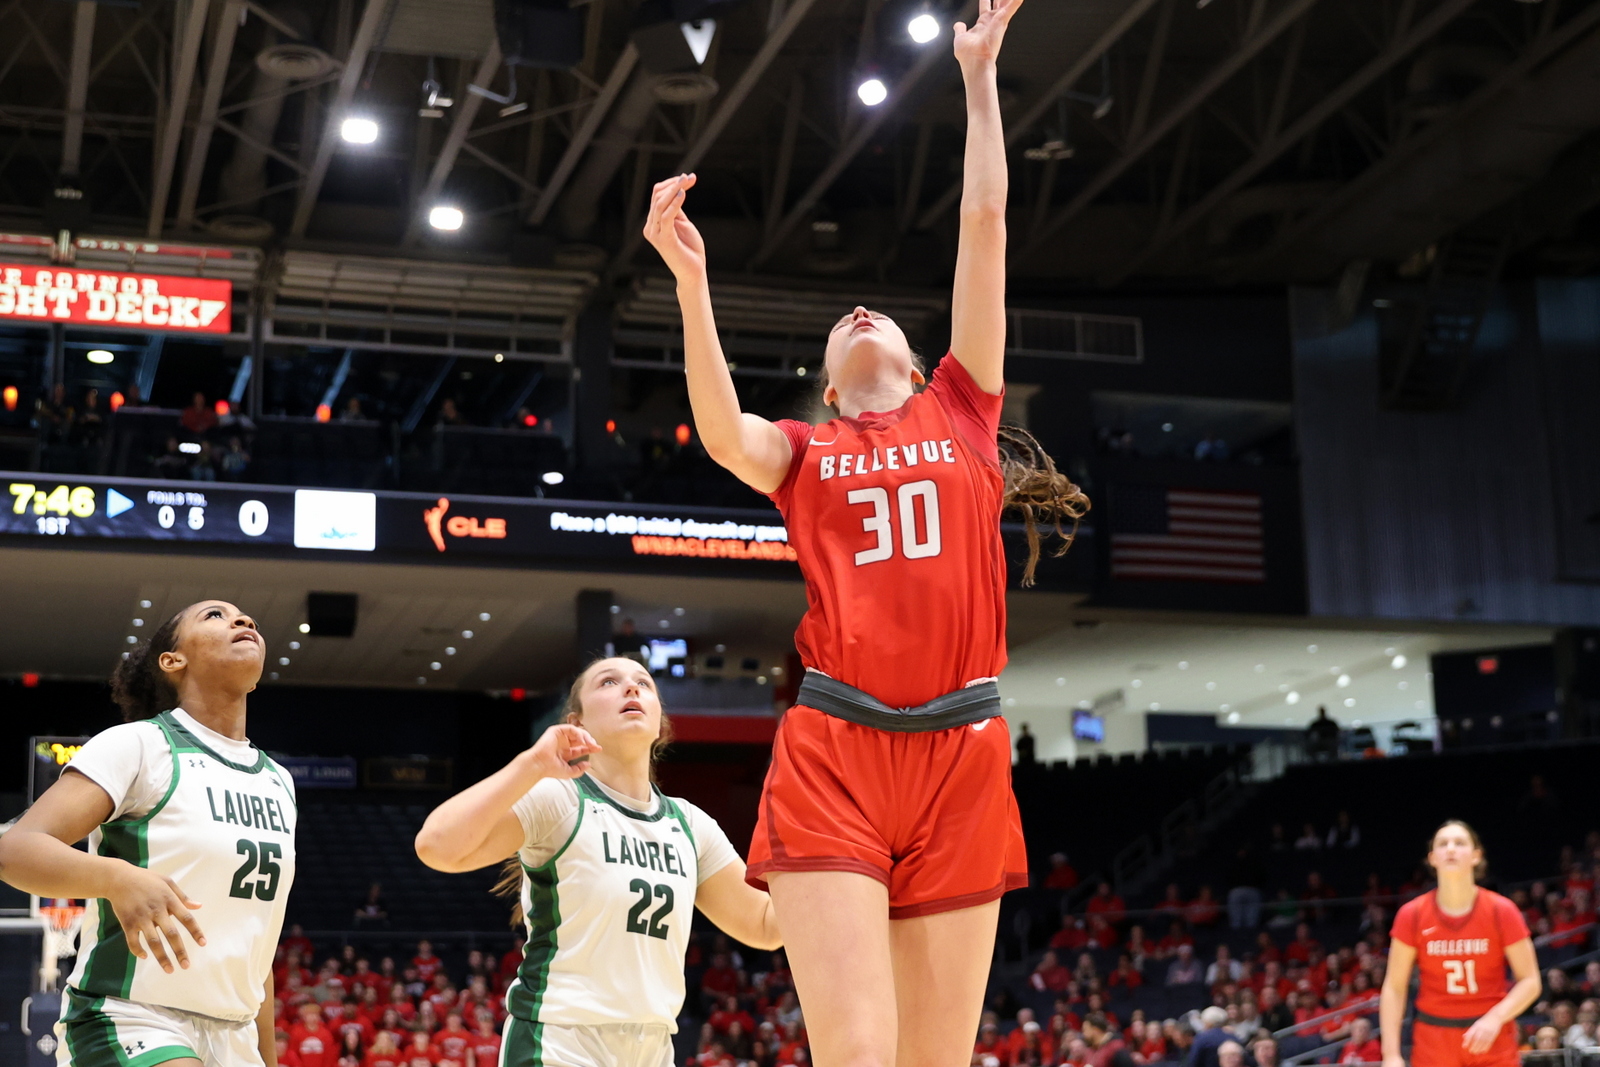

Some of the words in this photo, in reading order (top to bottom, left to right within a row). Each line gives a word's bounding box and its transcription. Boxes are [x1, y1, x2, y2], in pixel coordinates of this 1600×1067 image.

[36, 270, 160, 297] CONNOR
[86, 290, 200, 328] DECK
[819, 437, 956, 482] BELLEVUE
[9, 483, 96, 518] 7:46
[158, 505, 176, 529] 0
[188, 506, 205, 530] 5
[238, 500, 269, 537] 0
[36, 516, 71, 535] 1ST
[446, 516, 507, 539] CLE
[846, 479, 943, 567] 30
[206, 786, 291, 834] LAUREL
[229, 839, 282, 901] 25
[602, 831, 687, 878] LAUREL
[626, 878, 674, 940] 22
[1426, 938, 1490, 957] BELLEVUE
[1442, 959, 1478, 995] 21
